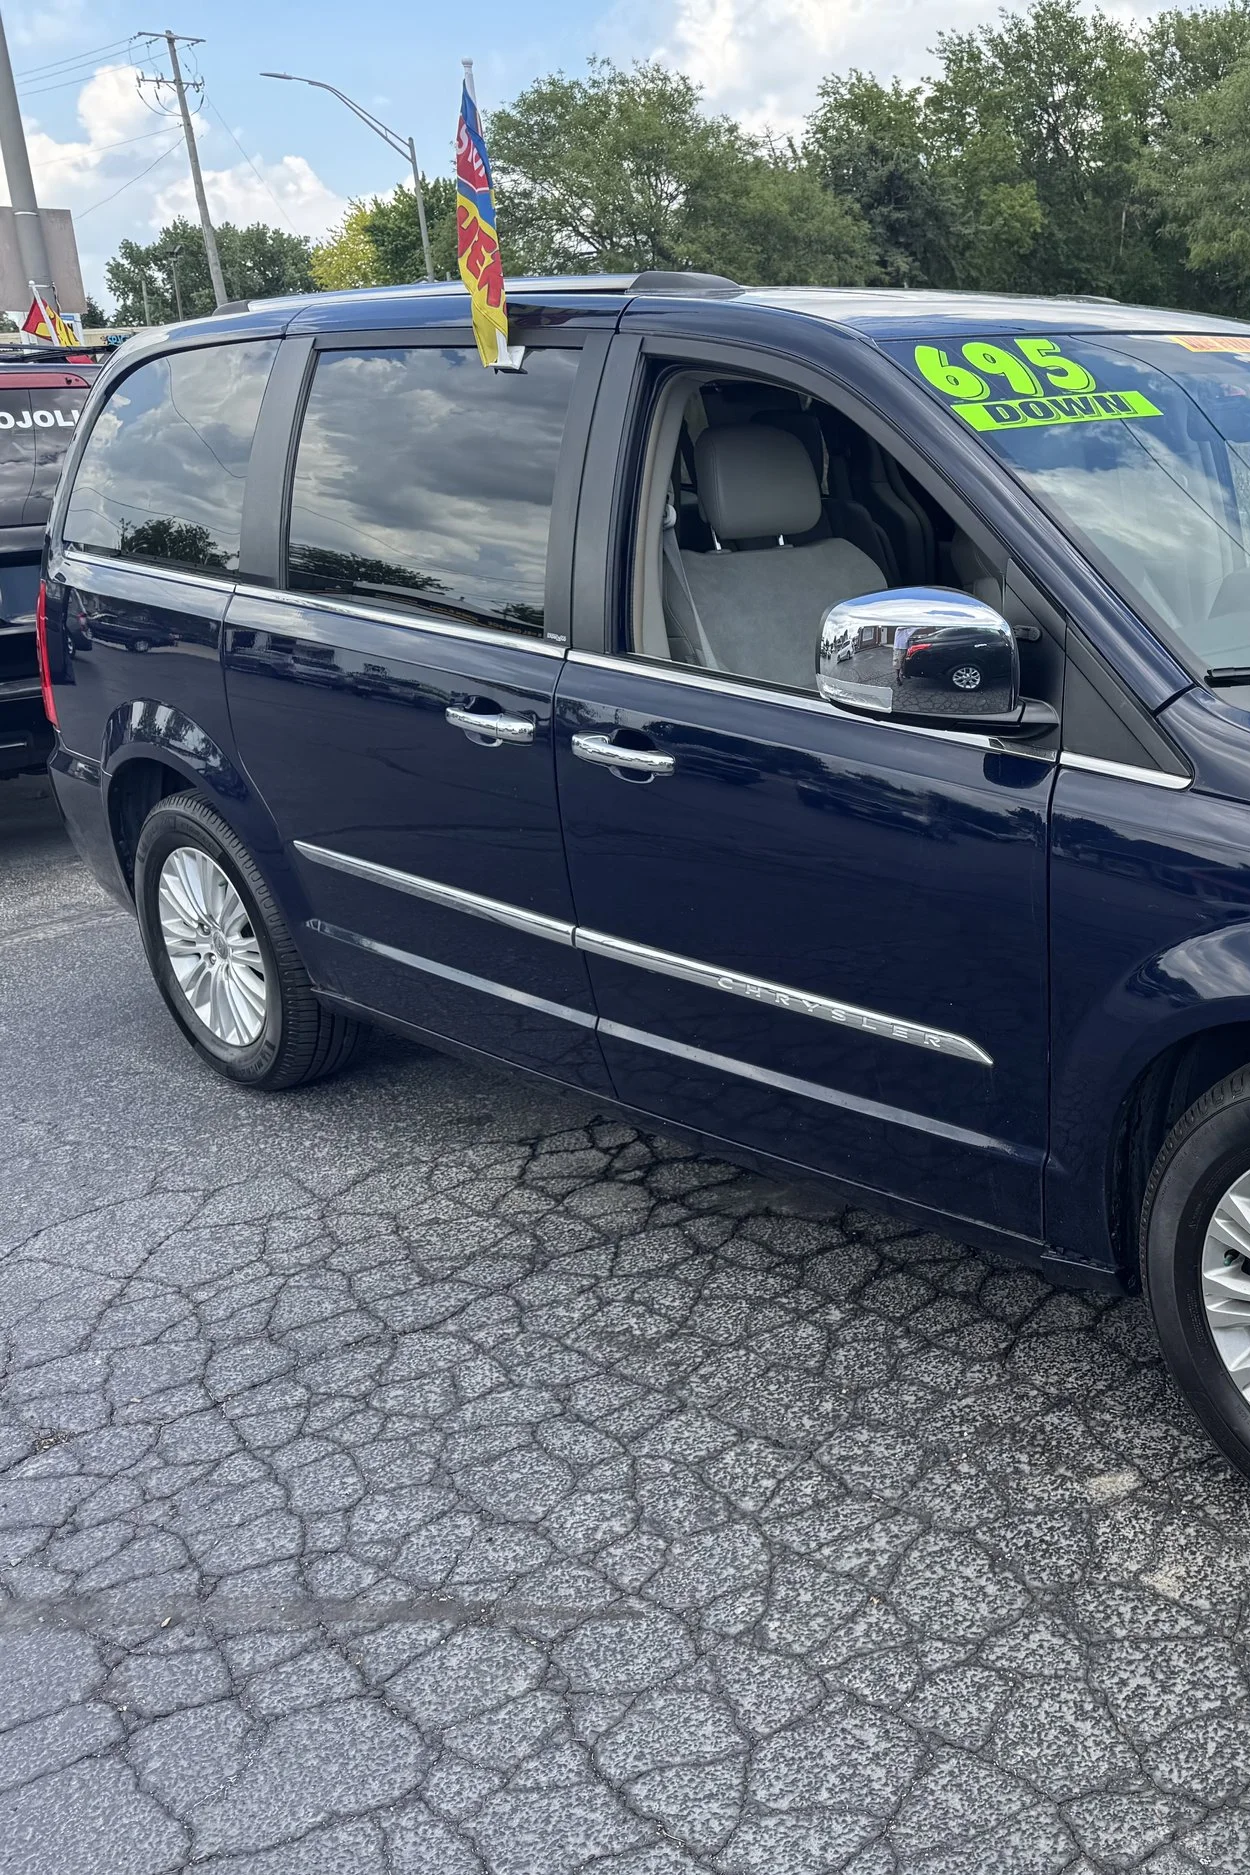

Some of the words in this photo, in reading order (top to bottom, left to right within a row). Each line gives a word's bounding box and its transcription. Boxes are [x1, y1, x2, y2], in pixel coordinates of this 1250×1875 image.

[914, 338, 1097, 401] 695
[981, 393, 1132, 425] DOWN
[718, 977, 941, 1047] CHRYSLER
